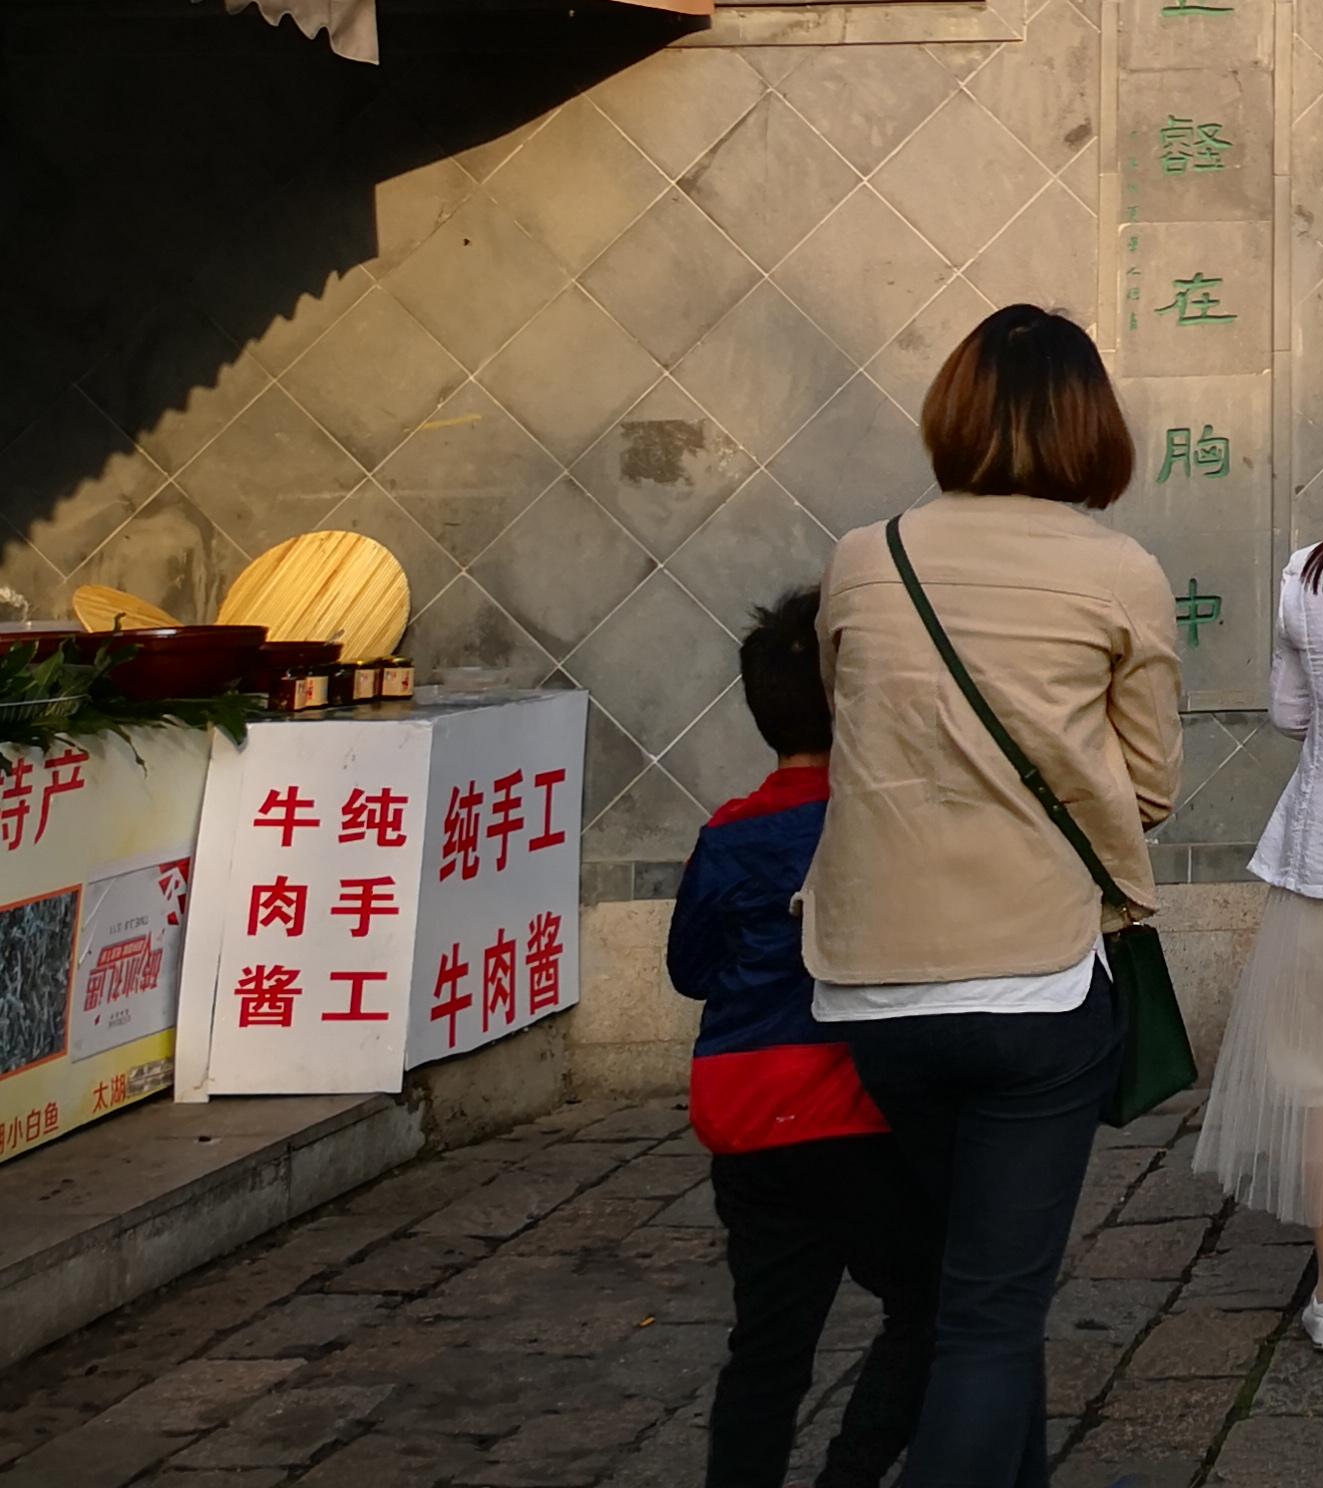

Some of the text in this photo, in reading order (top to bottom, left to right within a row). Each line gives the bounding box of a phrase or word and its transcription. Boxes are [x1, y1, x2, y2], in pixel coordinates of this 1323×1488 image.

[439, 768, 566, 883] 纯手工
[430, 910, 563, 1049] 牛肉酱
